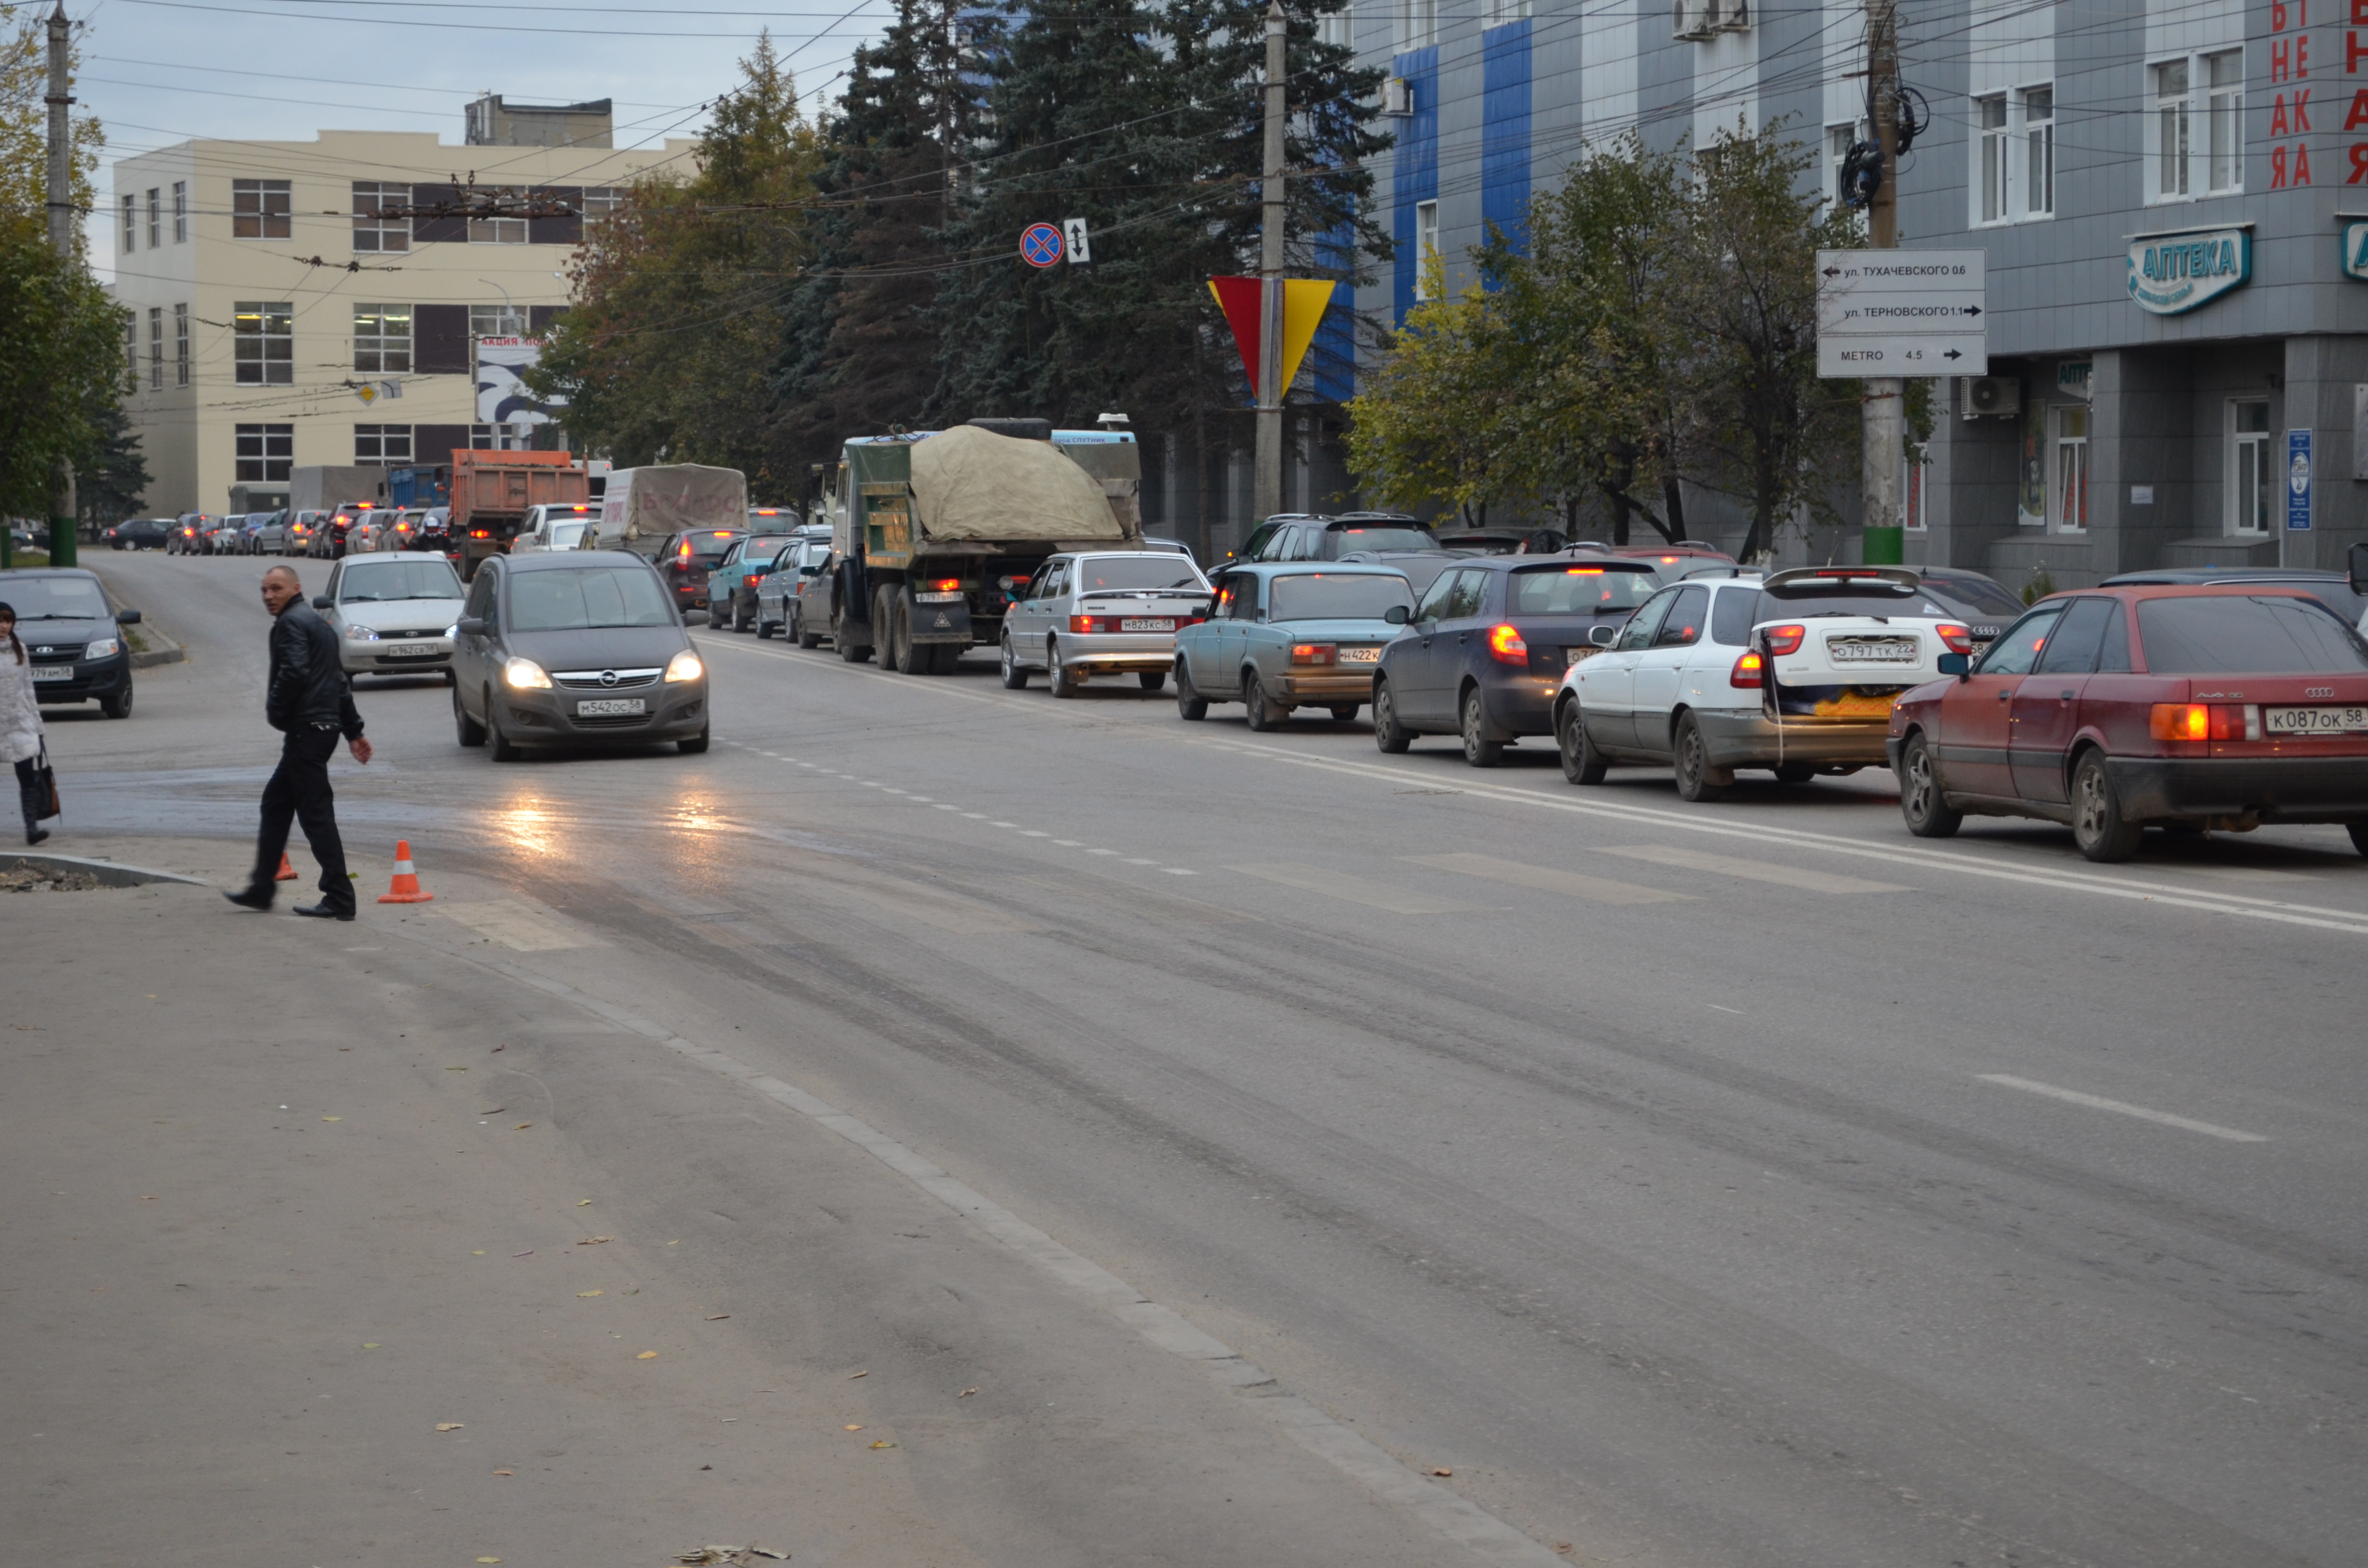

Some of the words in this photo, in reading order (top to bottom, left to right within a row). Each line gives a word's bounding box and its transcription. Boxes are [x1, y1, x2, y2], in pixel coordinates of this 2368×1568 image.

[2143, 238, 2236, 281] АПТЕКА
[1844, 269, 1859, 278] ул.
[1863, 266, 1949, 276] ТУХАЧЕВСКОГО
[1952, 266, 1966, 274] 0.6
[1844, 309, 1860, 319] ул.
[1864, 306, 1949, 317] ТЕРНОВСКОГО
[481, 338, 518, 346] АКЦИЯ
[1841, 351, 1883, 360] METRO
[1906, 351, 1922, 360] 4.5
[1124, 620, 1160, 629] М823КС
[1838, 646, 1893, 657] О797ТК
[1896, 645, 1910, 653] 22
[581, 699, 627, 713] М542ОС
[630, 700, 641, 708] 58
[2274, 711, 2342, 728] К087ОК
[2346, 710, 2363, 722] 58
